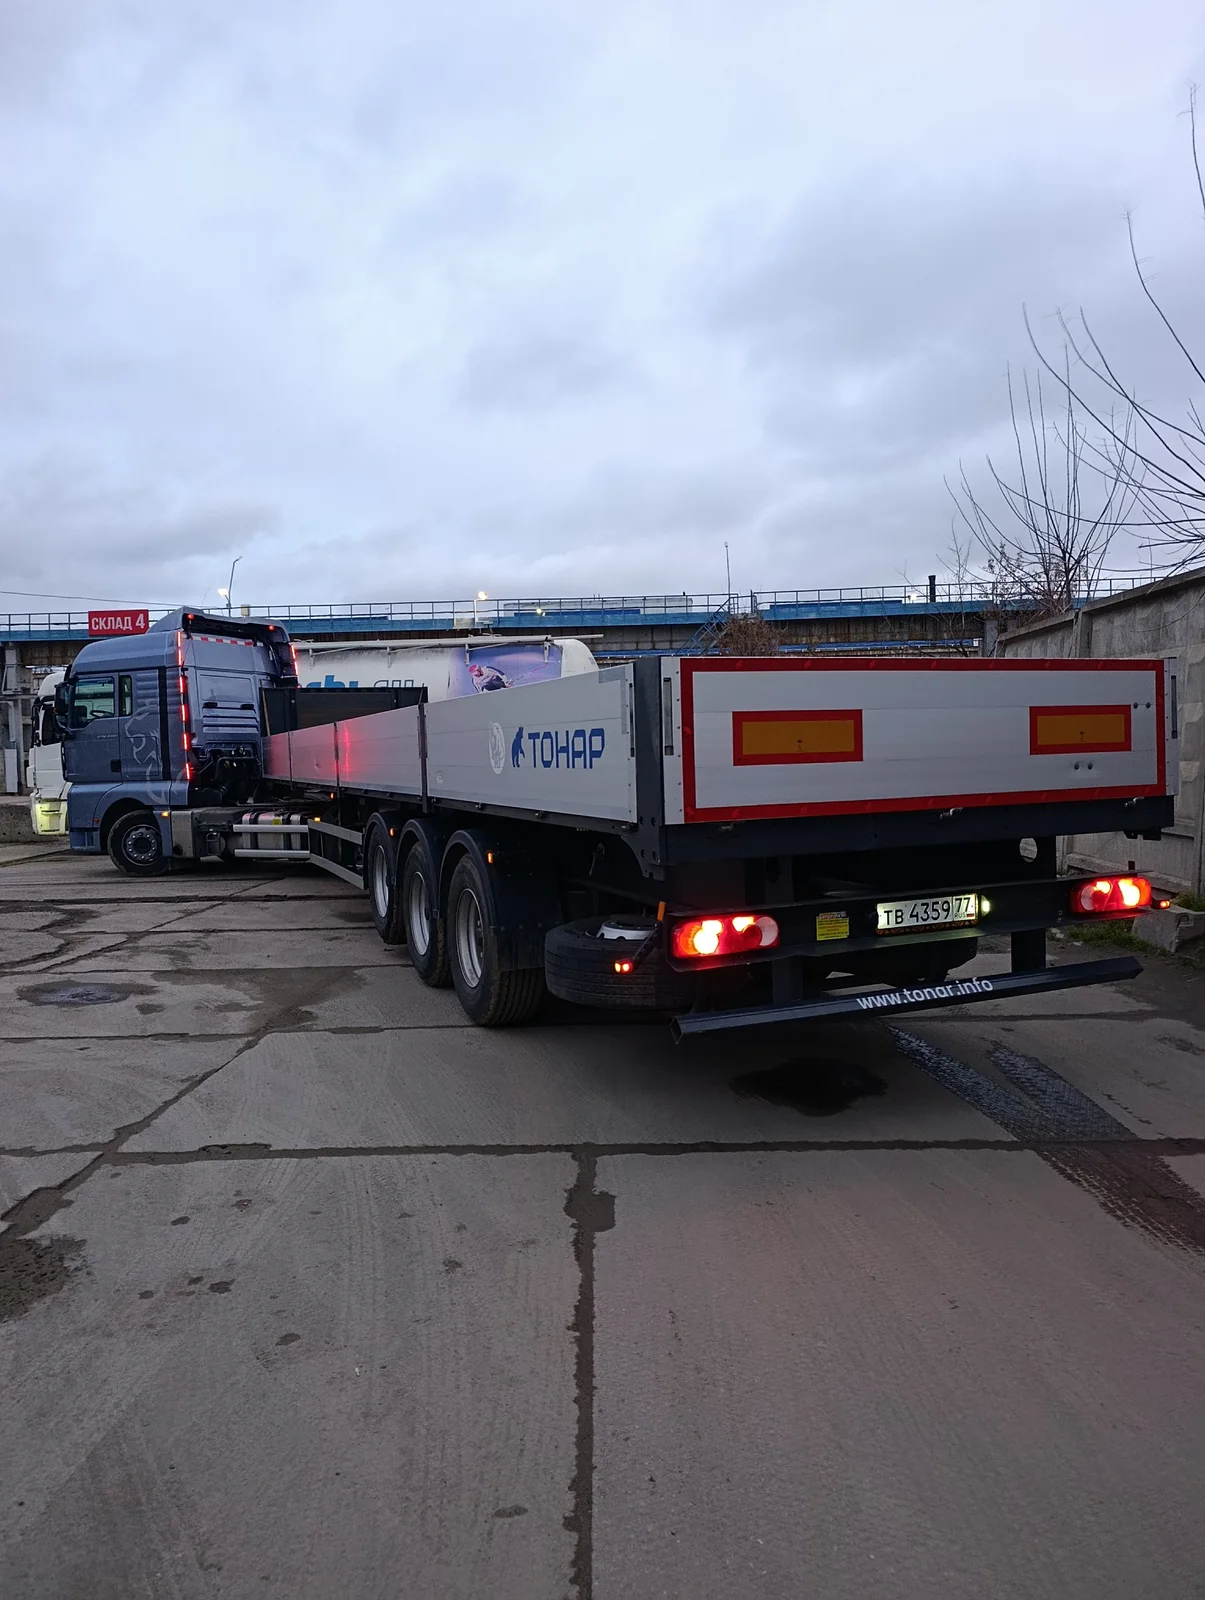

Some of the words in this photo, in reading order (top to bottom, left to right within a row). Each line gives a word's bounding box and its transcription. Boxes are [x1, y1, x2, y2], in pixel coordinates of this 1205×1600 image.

[92, 617, 132, 630] СКЛАД
[136, 613, 146, 628] 4
[528, 728, 605, 769] ТОНАР
[909, 901, 951, 922] 4359
[955, 897, 971, 912] 77
[856, 977, 994, 1009] www.tonar.info
